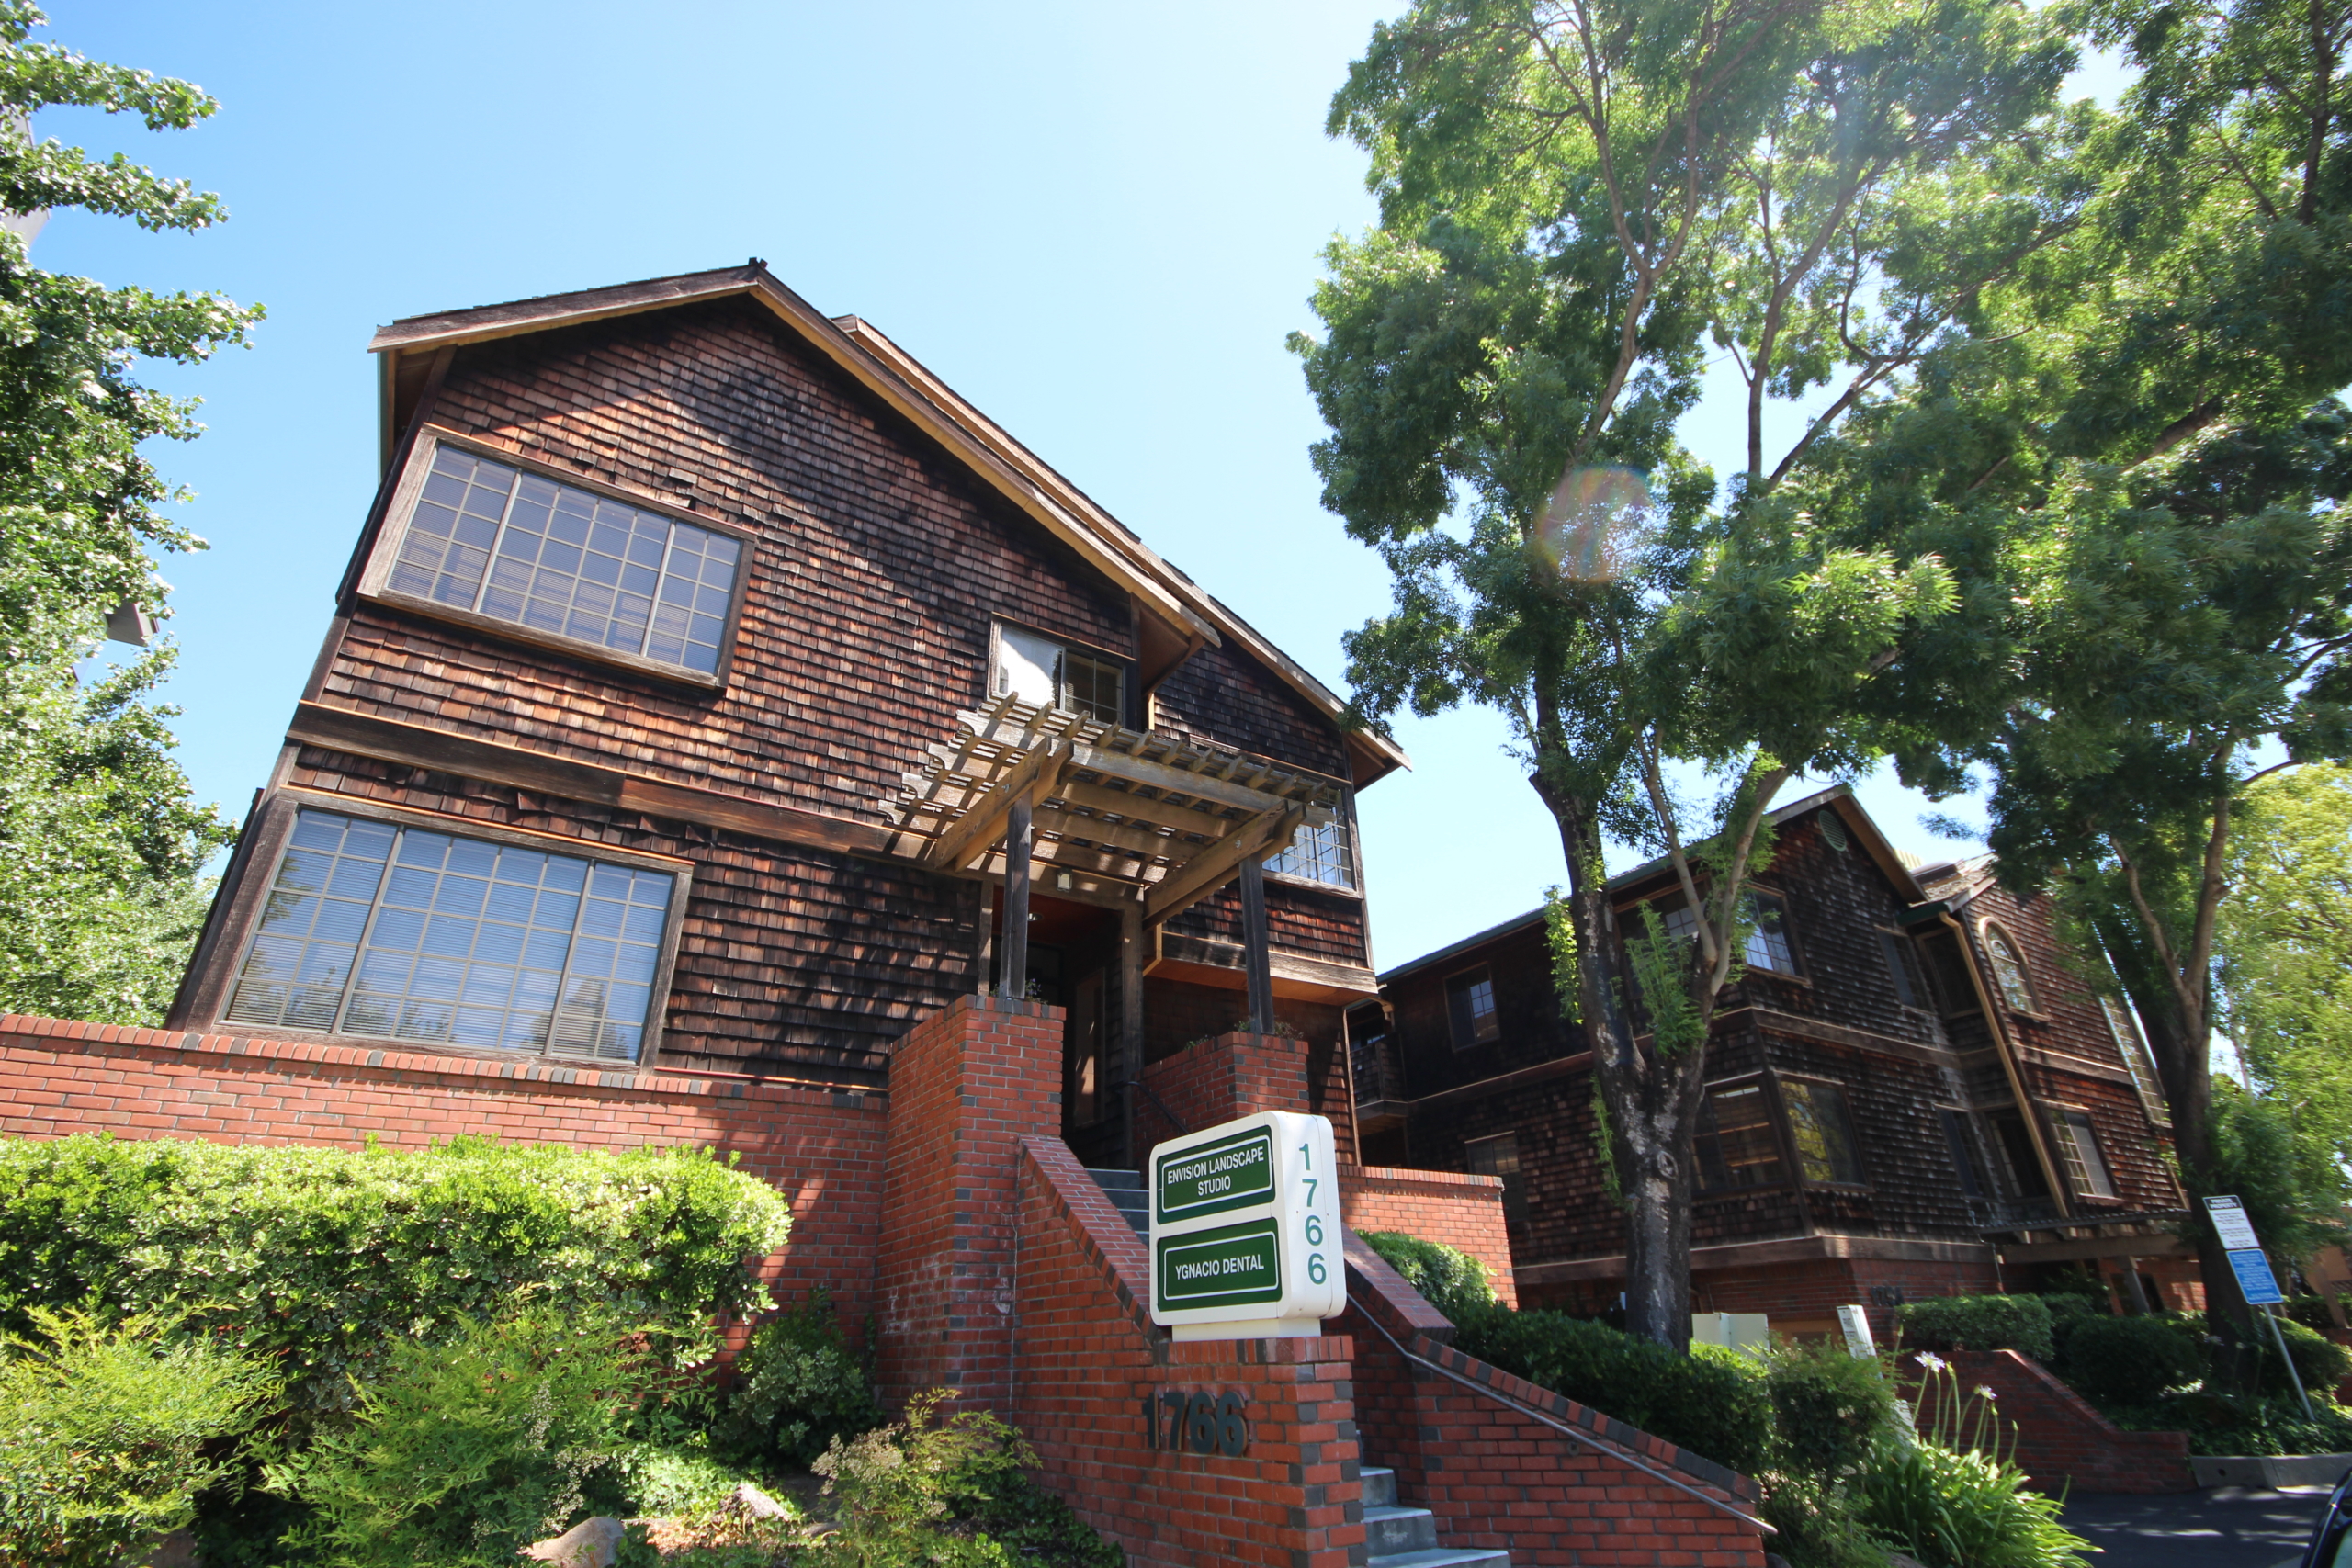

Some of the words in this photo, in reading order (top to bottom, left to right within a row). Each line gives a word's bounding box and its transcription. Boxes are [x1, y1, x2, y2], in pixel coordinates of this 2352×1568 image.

[1167, 1161, 1207, 1185] ENVISION
[1209, 1146, 1264, 1174] LANDSCAPE
[1197, 1175, 1231, 1197] STUDIO
[1299, 1143, 1327, 1285] 1766
[1175, 1259, 1220, 1280] YGNACIO
[1222, 1254, 1265, 1275] DENTAL
[1142, 1391, 1248, 1457] 1766
